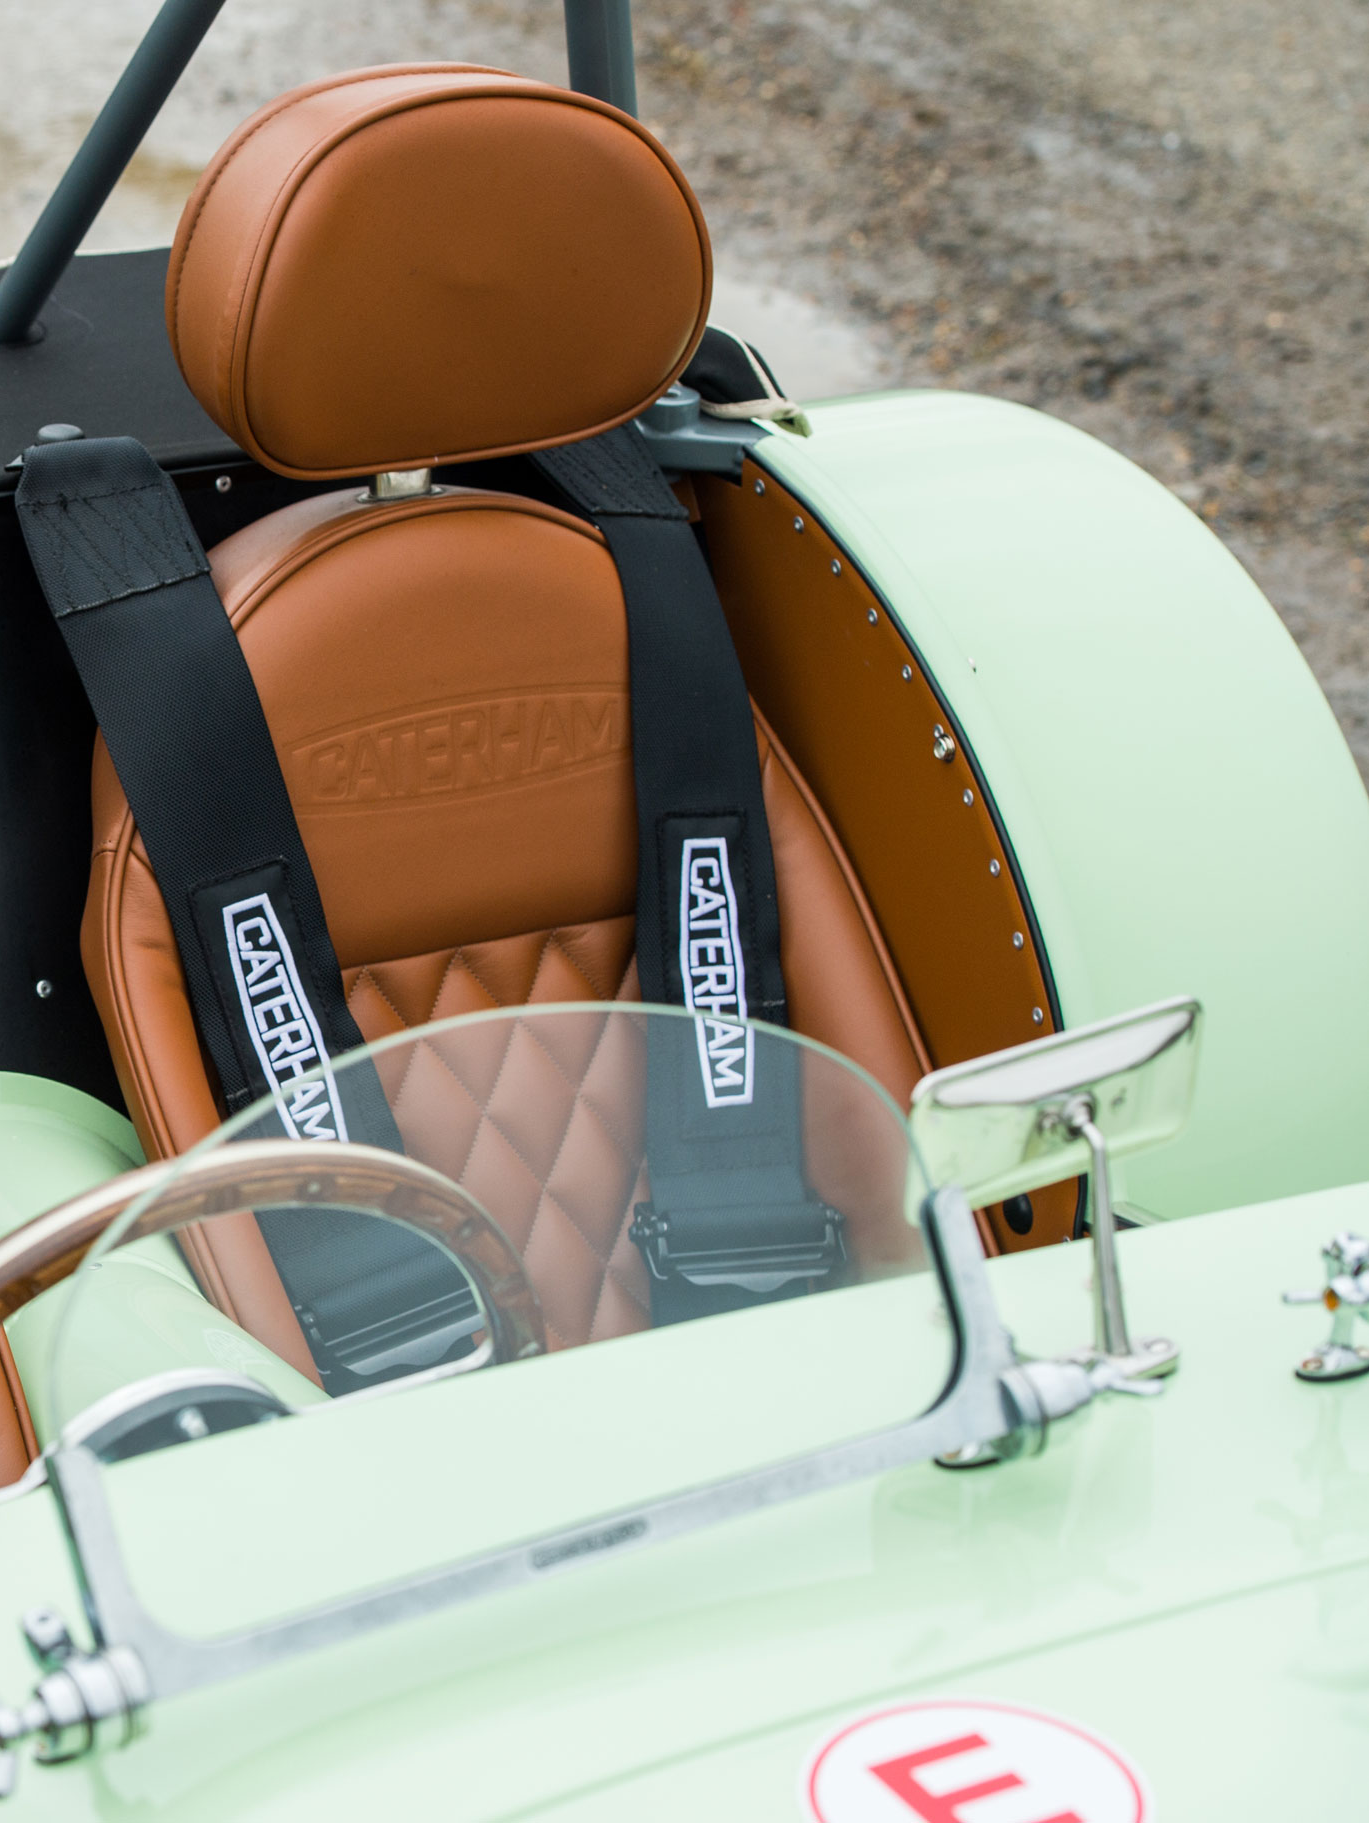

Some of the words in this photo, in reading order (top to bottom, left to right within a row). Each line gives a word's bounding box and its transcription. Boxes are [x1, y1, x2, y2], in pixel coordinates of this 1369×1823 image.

[310, 700, 623, 800] CATERHAM
[236, 916, 336, 1140] CATERHAM
[689, 857, 745, 1088] CATERHAM
[868, 1732, 1085, 1823] E
